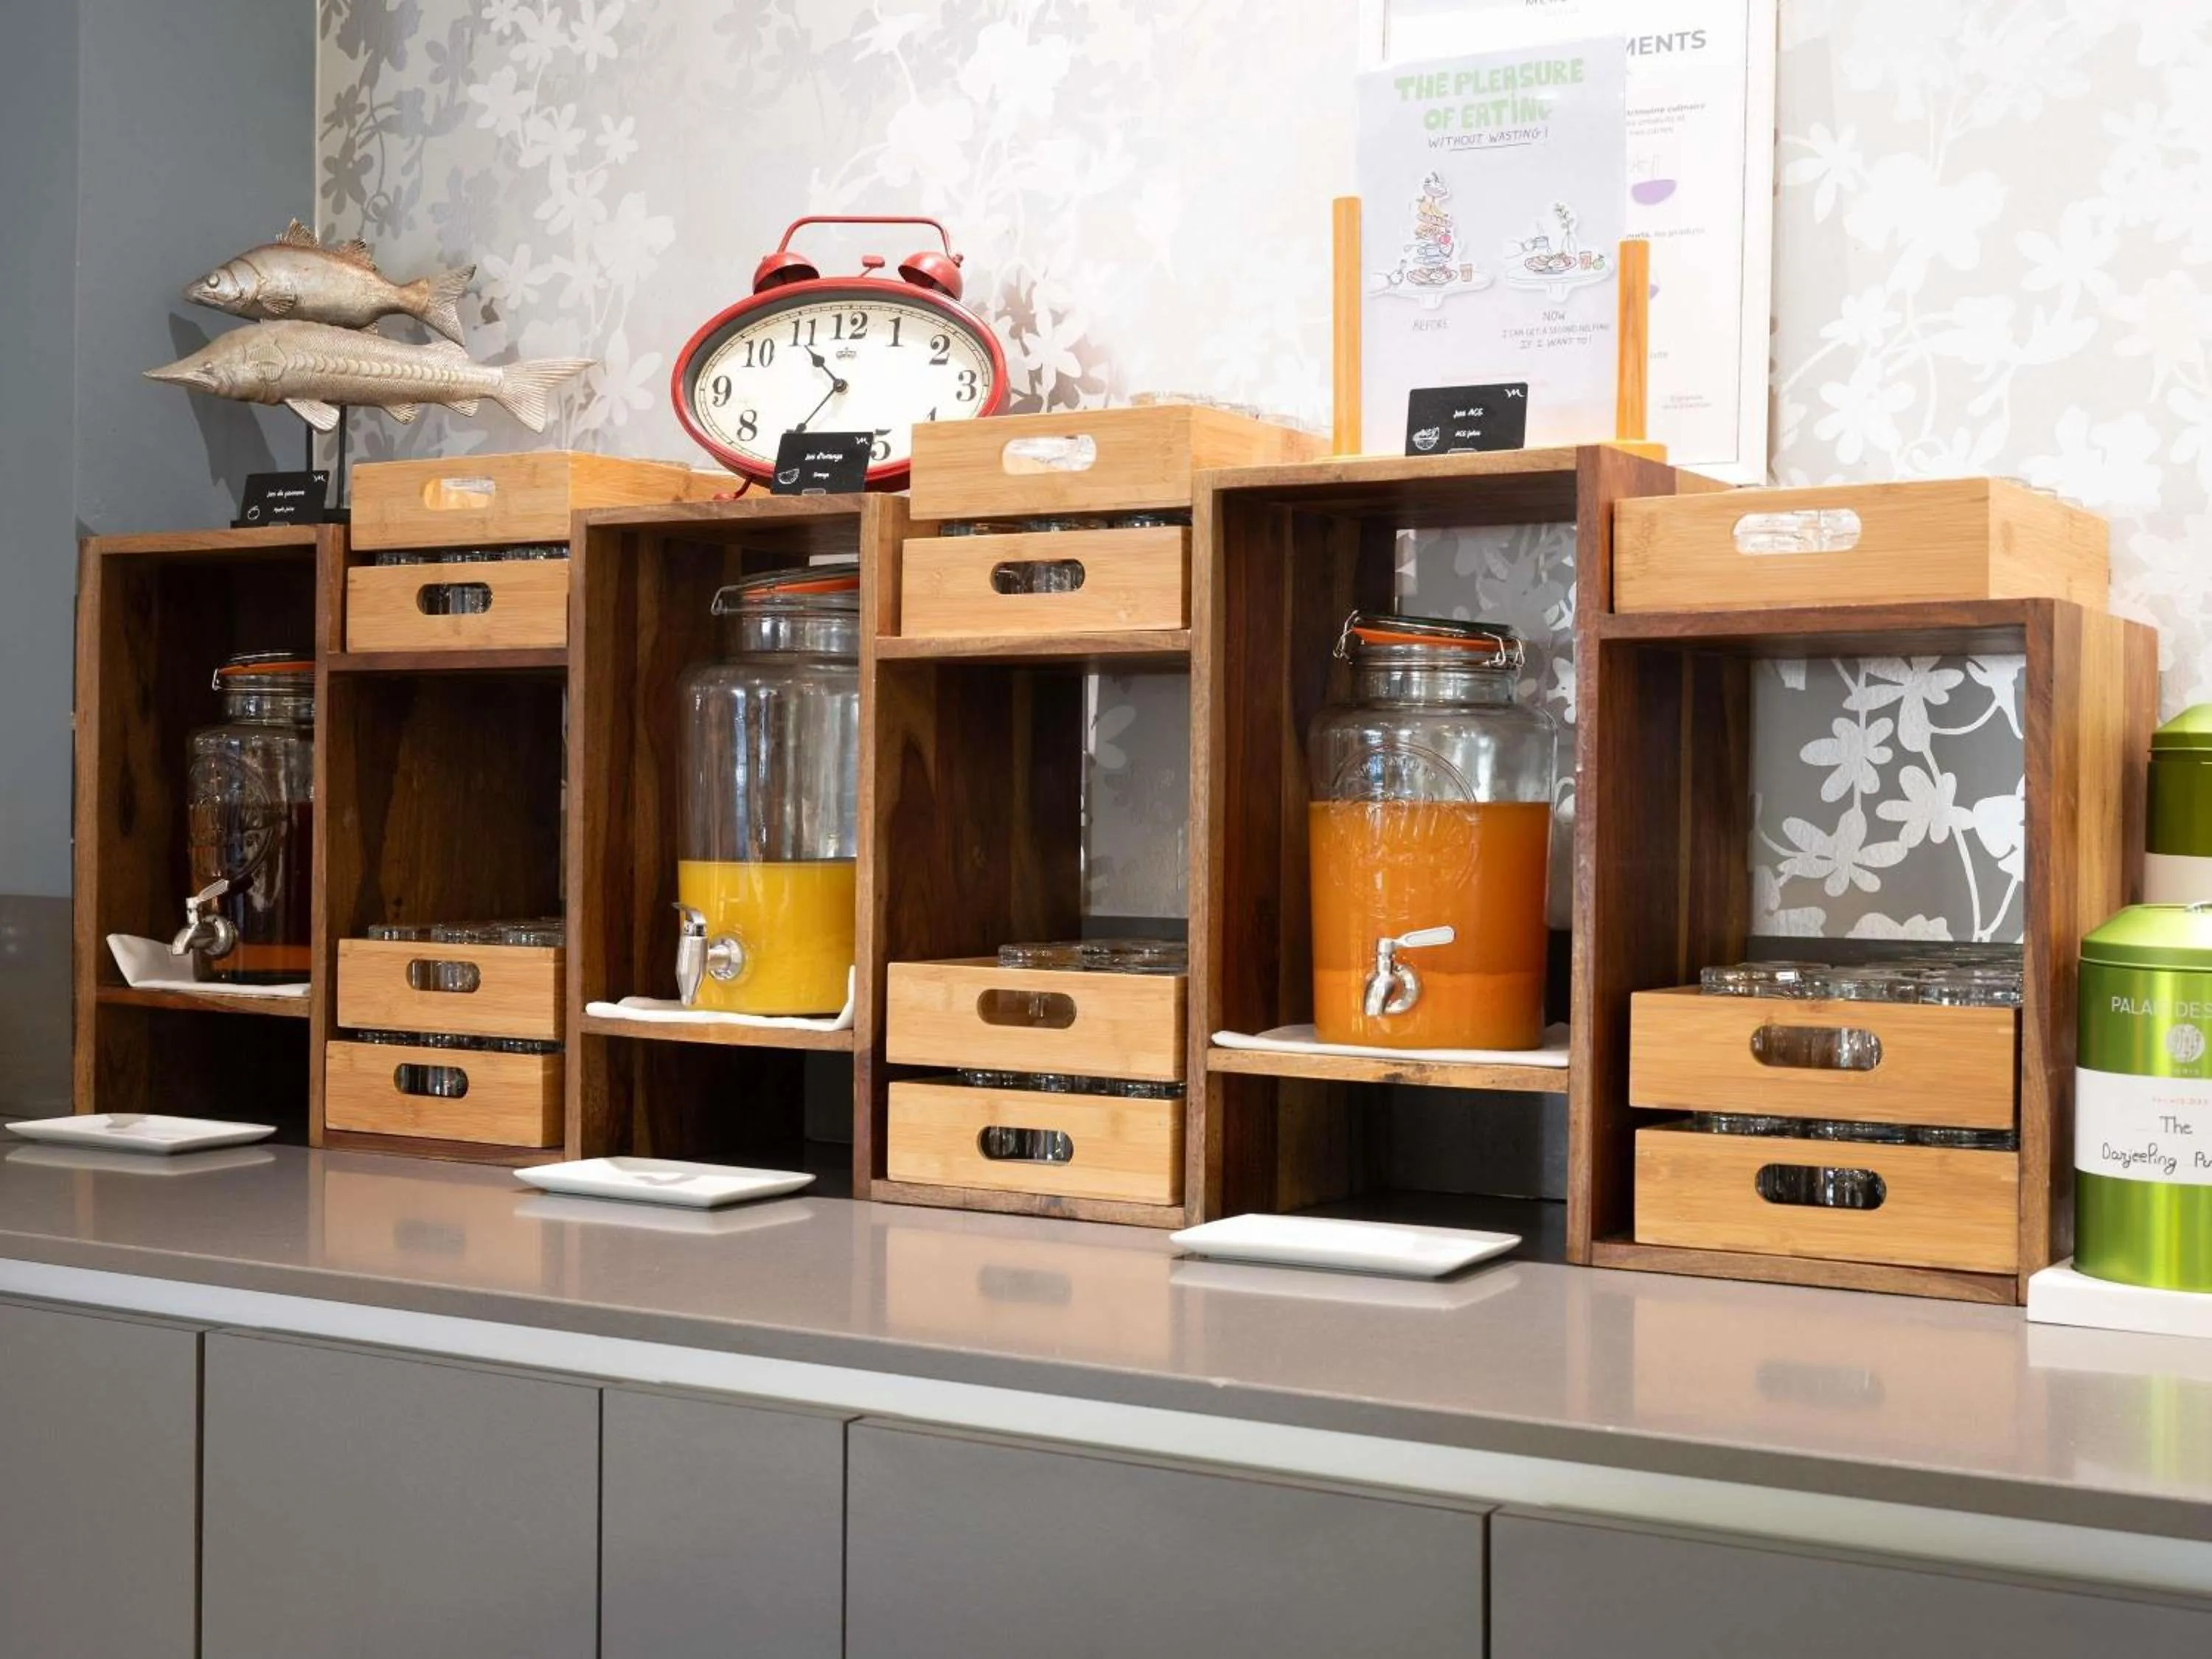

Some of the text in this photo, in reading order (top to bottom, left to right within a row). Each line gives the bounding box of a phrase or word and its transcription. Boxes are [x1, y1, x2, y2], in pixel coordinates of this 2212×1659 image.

[1394, 58, 1585, 102] THE PLEASURE
[1424, 106, 1455, 131] OF
[1428, 133, 1484, 148] WITHOUT
[829, 310, 869, 341] 12
[1412, 318, 1450, 332] BEFORE
[1542, 310, 1566, 321] NOW
[787, 318, 818, 347] 11
[885, 316, 905, 347] 1
[742, 338, 775, 368] 10
[929, 333, 950, 366] 2
[712, 375, 732, 407] 9
[956, 369, 977, 402] 3
[737, 409, 757, 442] 8
[870, 428, 892, 461] 5
[2110, 995, 2168, 1019] PALAI
[2101, 1141, 2178, 1176] Darjeeling
